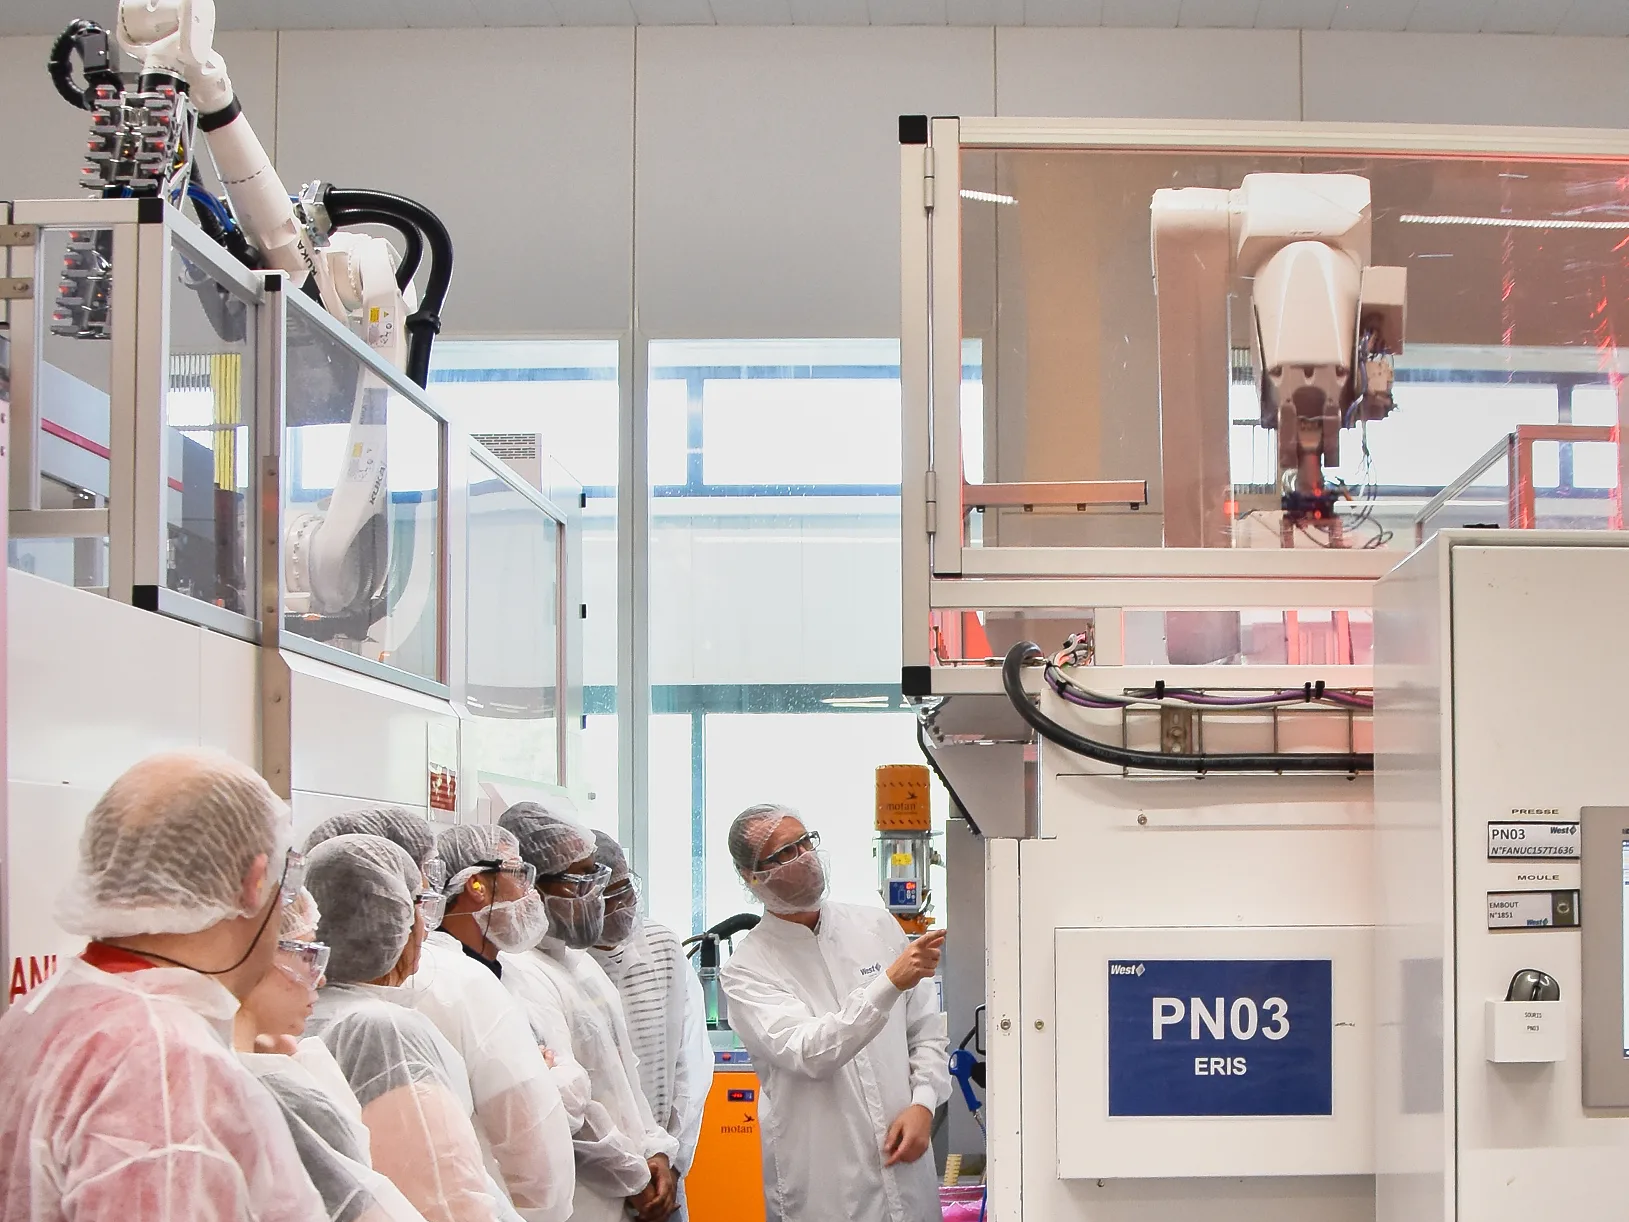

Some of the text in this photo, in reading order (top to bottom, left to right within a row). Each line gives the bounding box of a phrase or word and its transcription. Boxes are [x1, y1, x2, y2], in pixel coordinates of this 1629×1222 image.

[297, 239, 317, 276] KUKA
[369, 465, 386, 505] KUKA
[886, 802, 916, 811] motan
[1492, 829, 1526, 840] PN03
[1550, 826, 1570, 834] West
[1489, 901, 1519, 909] EMBOUT
[860, 966, 876, 976] West
[1110, 964, 1136, 975] West
[10, 954, 57, 1005] AN
[1152, 996, 1291, 1041] PN03
[1194, 1057, 1247, 1076] ERIS
[721, 1125, 753, 1133] motan
